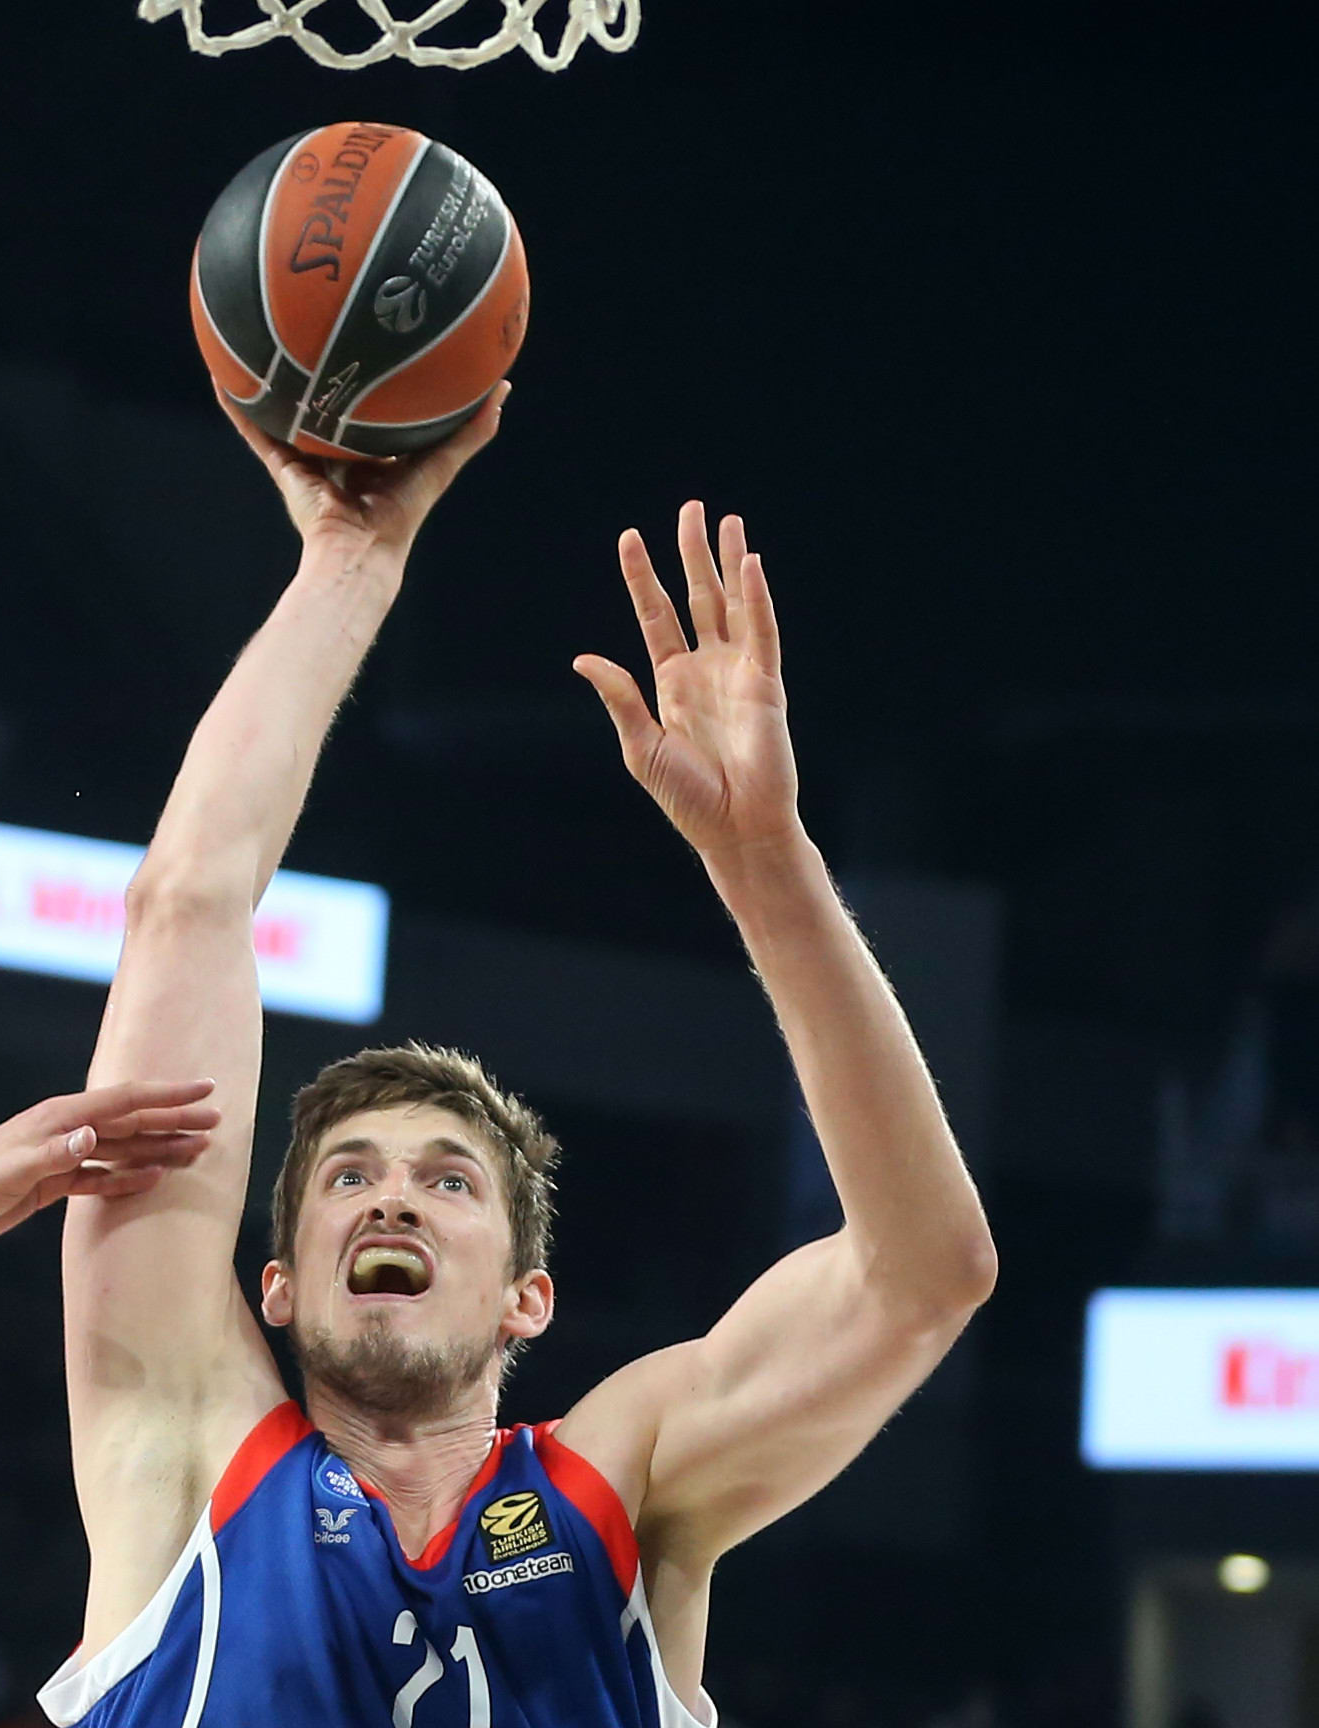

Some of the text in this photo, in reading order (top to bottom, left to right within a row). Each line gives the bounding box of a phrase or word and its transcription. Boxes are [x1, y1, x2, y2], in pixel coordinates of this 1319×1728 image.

[291, 123, 396, 281] SPALDIN
[490, 1520, 544, 1547] TURKISH
[493, 1529, 547, 1554] AIRLINES
